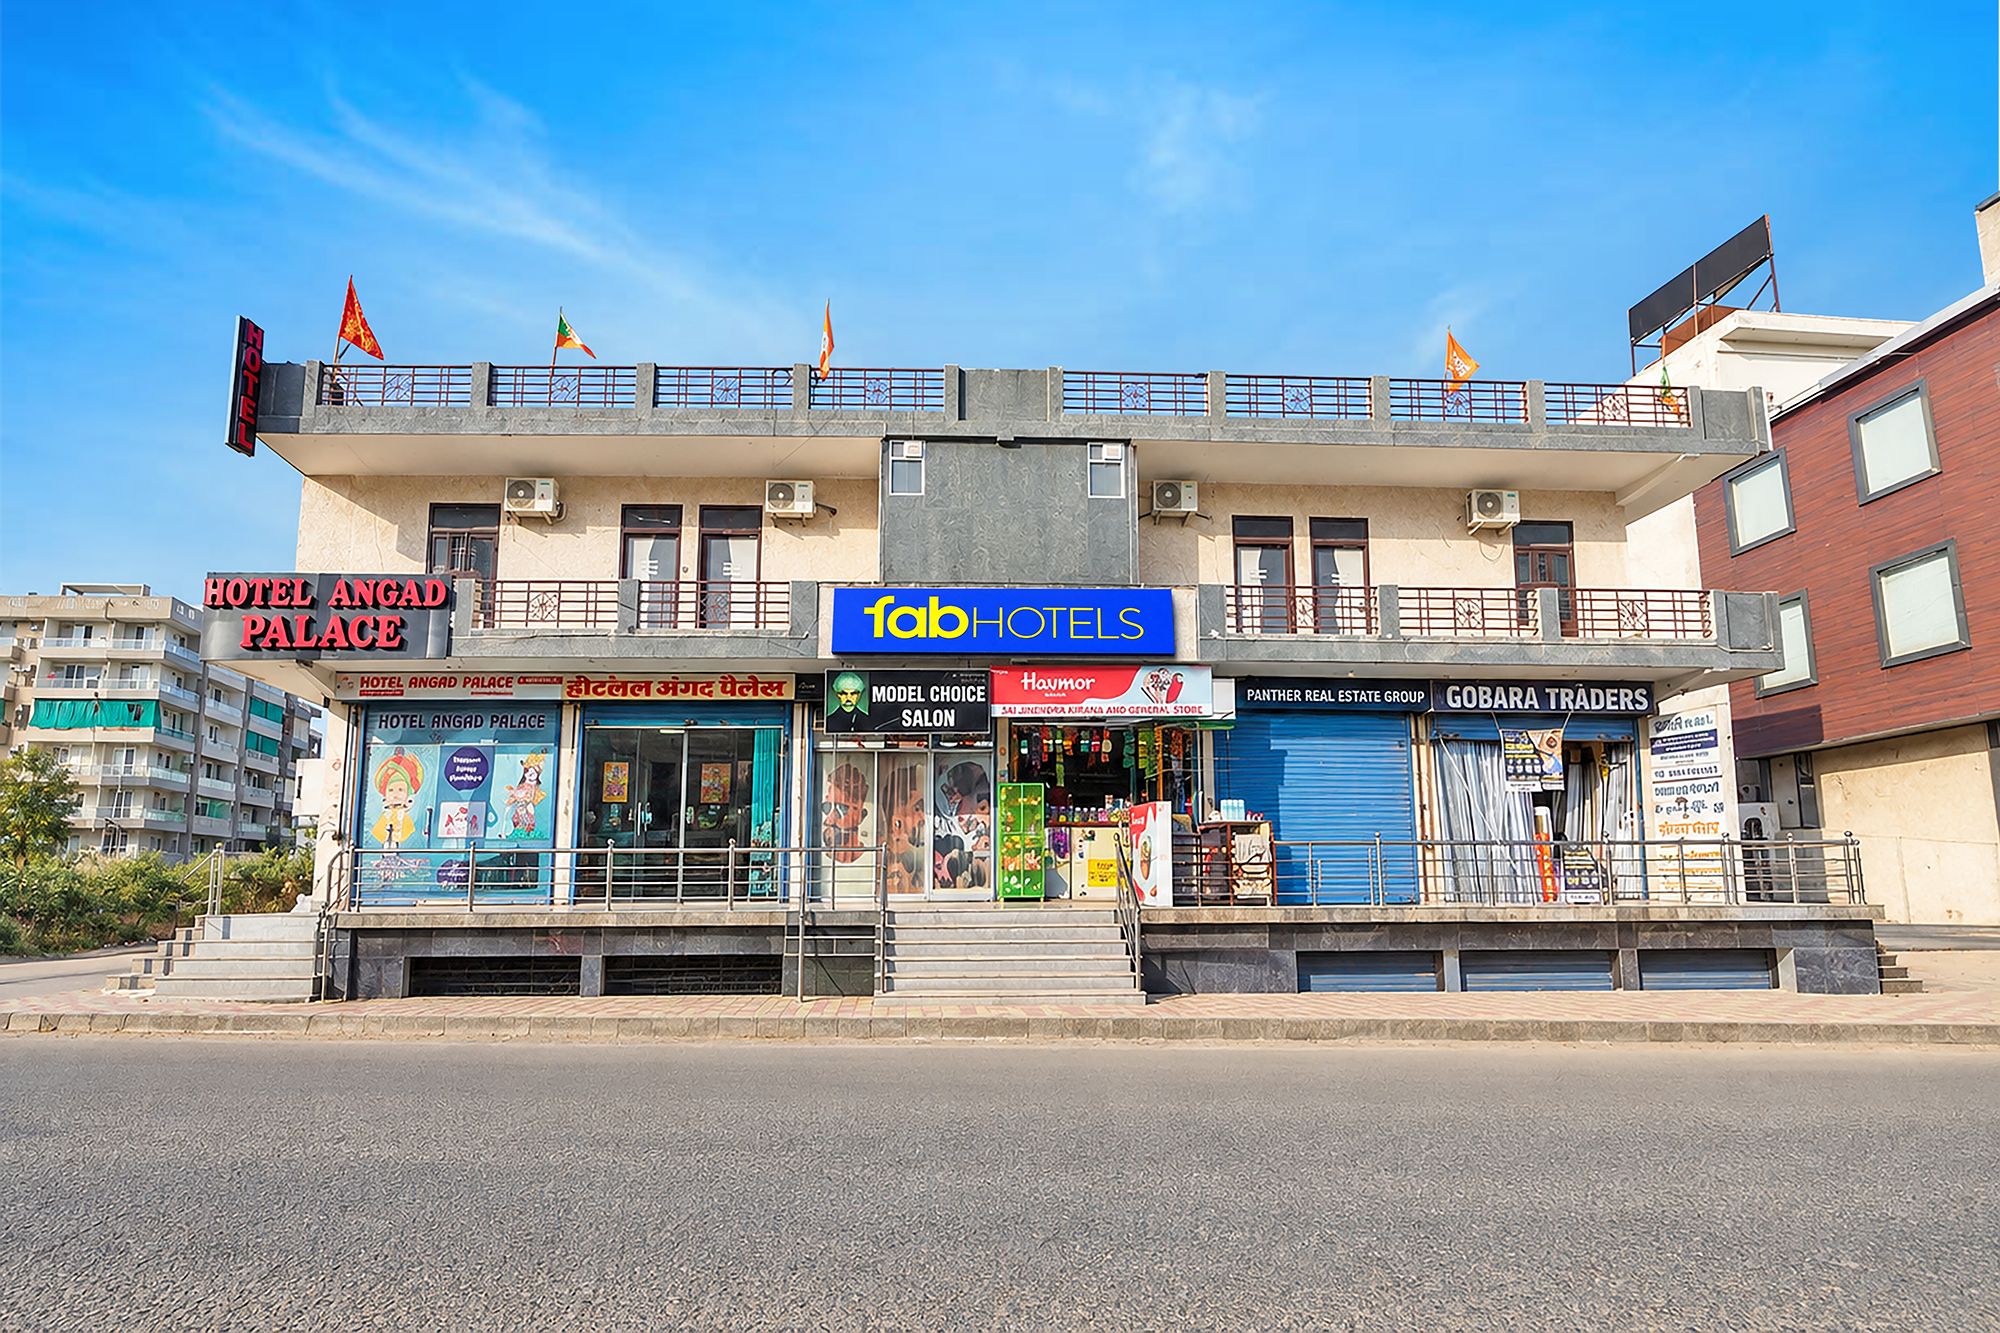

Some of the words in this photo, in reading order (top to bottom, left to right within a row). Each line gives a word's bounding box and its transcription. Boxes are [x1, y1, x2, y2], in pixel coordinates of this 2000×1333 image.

[237, 321, 263, 450] HOTEL
[203, 578, 312, 606] HOTEL
[328, 578, 447, 607] ANGAD
[240, 615, 401, 648] PALACE
[359, 676, 404, 689] HOTEL
[408, 676, 458, 689] ANGAD
[462, 676, 514, 689] PALACE
[655, 675, 716, 698] अंगद
[1020, 671, 1096, 691] Havmor
[872, 685, 925, 703] MODEL
[930, 685, 986, 703] CHOICE
[1247, 689, 1301, 702] PANTHER
[1305, 689, 1335, 702] REAL
[1338, 690, 1381, 703] ESTATE
[1384, 690, 1425, 703] GROUP
[1446, 685, 1540, 710] GOBARA
[378, 714, 426, 729] HOTEL
[431, 714, 484, 729] ANGAD
[489, 714, 546, 729] PALACE
[901, 708, 955, 727] SALON
